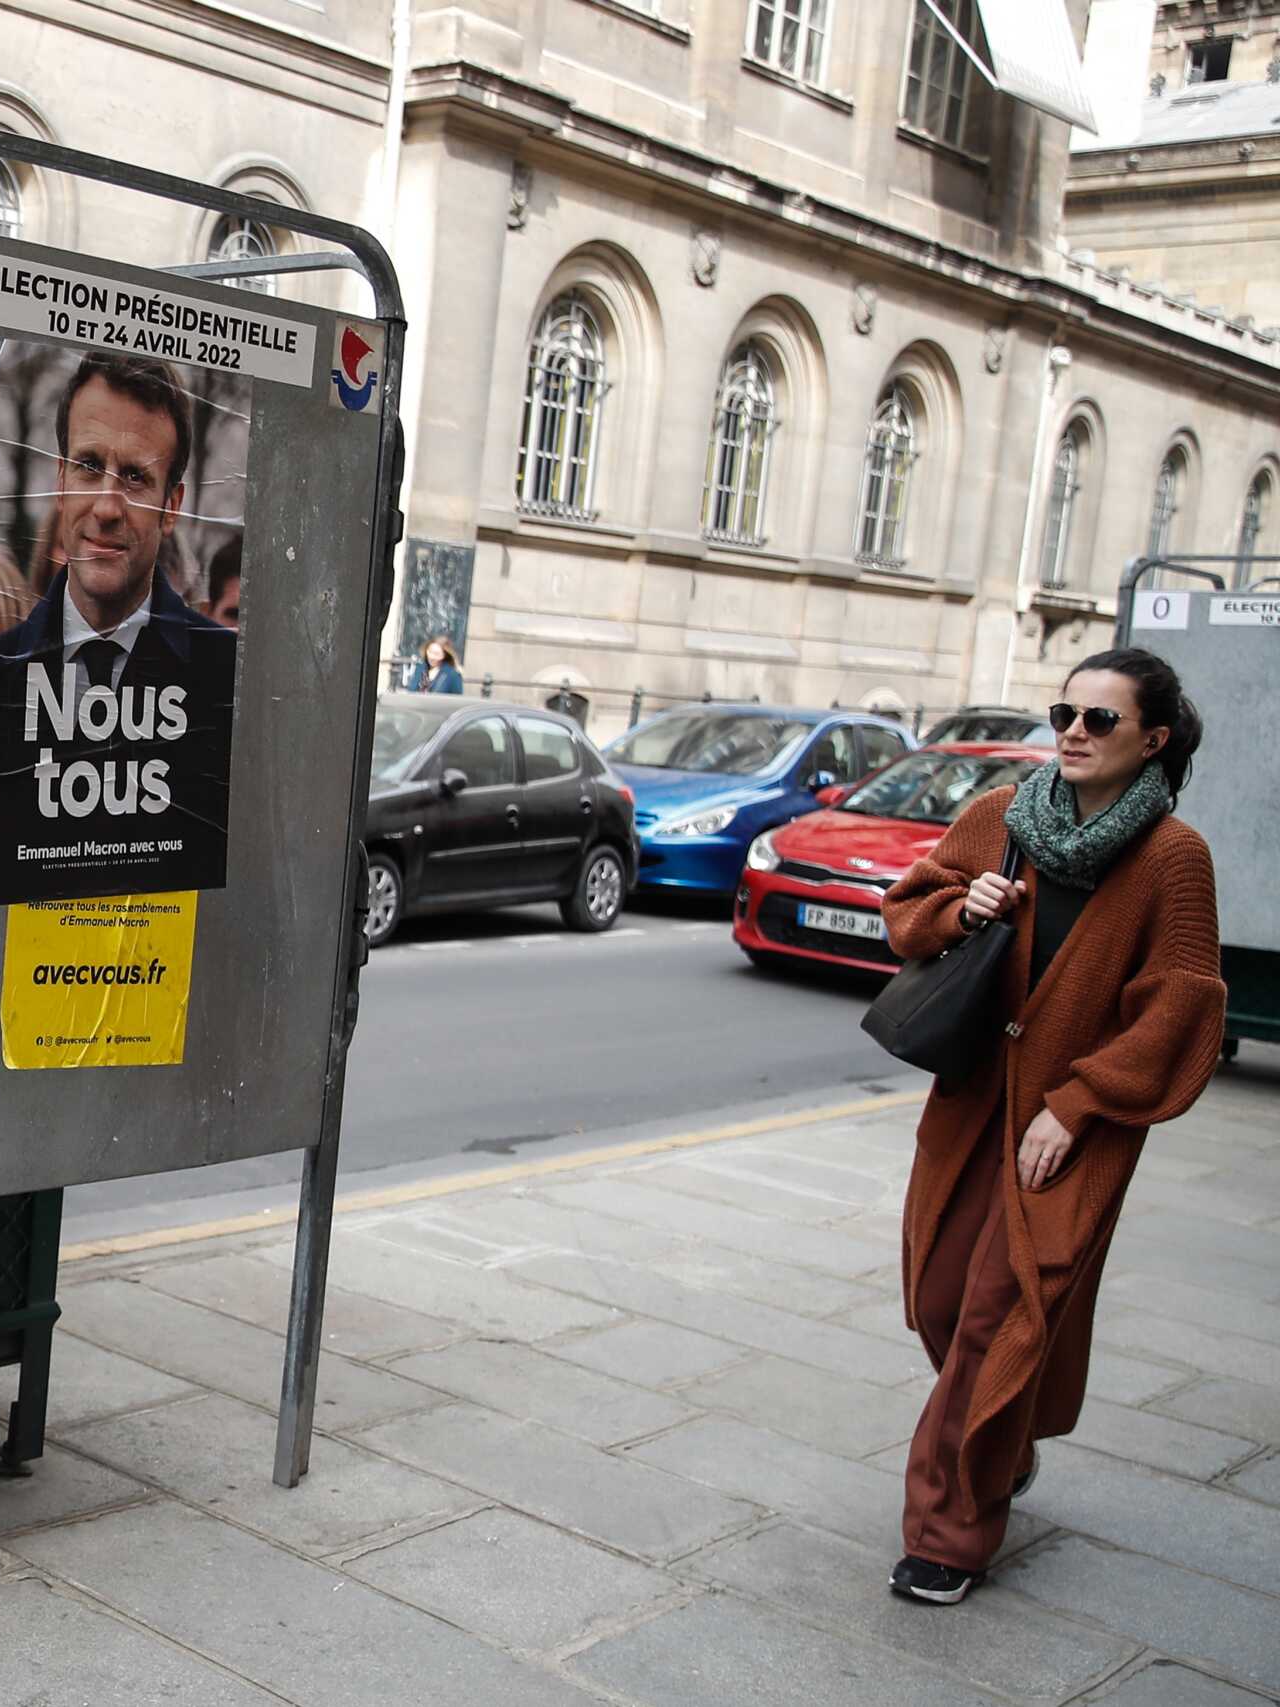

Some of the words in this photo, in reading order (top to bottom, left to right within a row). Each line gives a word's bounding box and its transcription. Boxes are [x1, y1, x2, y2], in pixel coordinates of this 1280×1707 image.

[115, 292, 297, 353] PRÉSIDENTIELLE
[48, 310, 70, 334] 10
[76, 319, 98, 340] ET
[103, 322, 128, 346] 24
[133, 328, 192, 360] AVRIL
[197, 341, 241, 369] 2022
[1153, 595, 1170, 620] 0
[24, 662, 188, 741] Nous
[34, 748, 170, 818] tous
[17, 842, 81, 860] Emmanuel
[84, 841, 127, 856] Macron
[130, 841, 155, 853] avec
[158, 839, 183, 851] vous
[28, 901, 74, 911] Retrouvez
[76, 901, 96, 912] tous
[98, 901, 110, 912] les
[60, 915, 116, 927] d'Emmanuel
[119, 917, 150, 927] Macron
[33, 958, 166, 985] avecvous.fr
